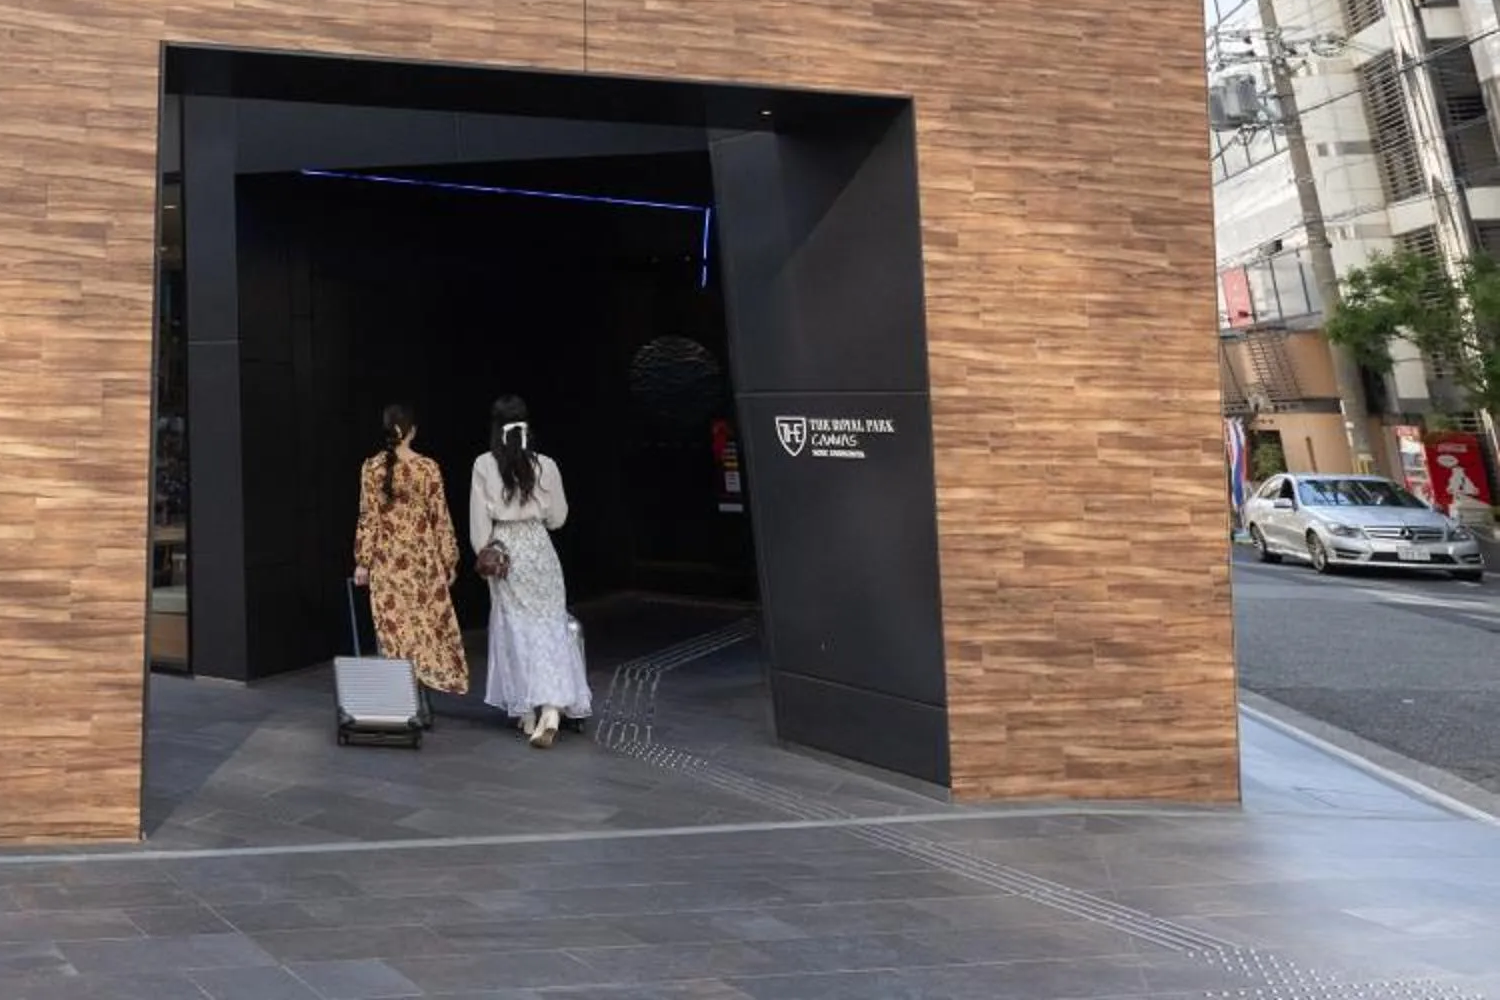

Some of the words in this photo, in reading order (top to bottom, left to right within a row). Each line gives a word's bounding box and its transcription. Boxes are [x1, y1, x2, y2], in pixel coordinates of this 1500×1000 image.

[809, 419, 831, 431] THE
[831, 419, 865, 432] ROYAL
[865, 419, 895, 433] PARK
[811, 433, 858, 447] CANVAS
